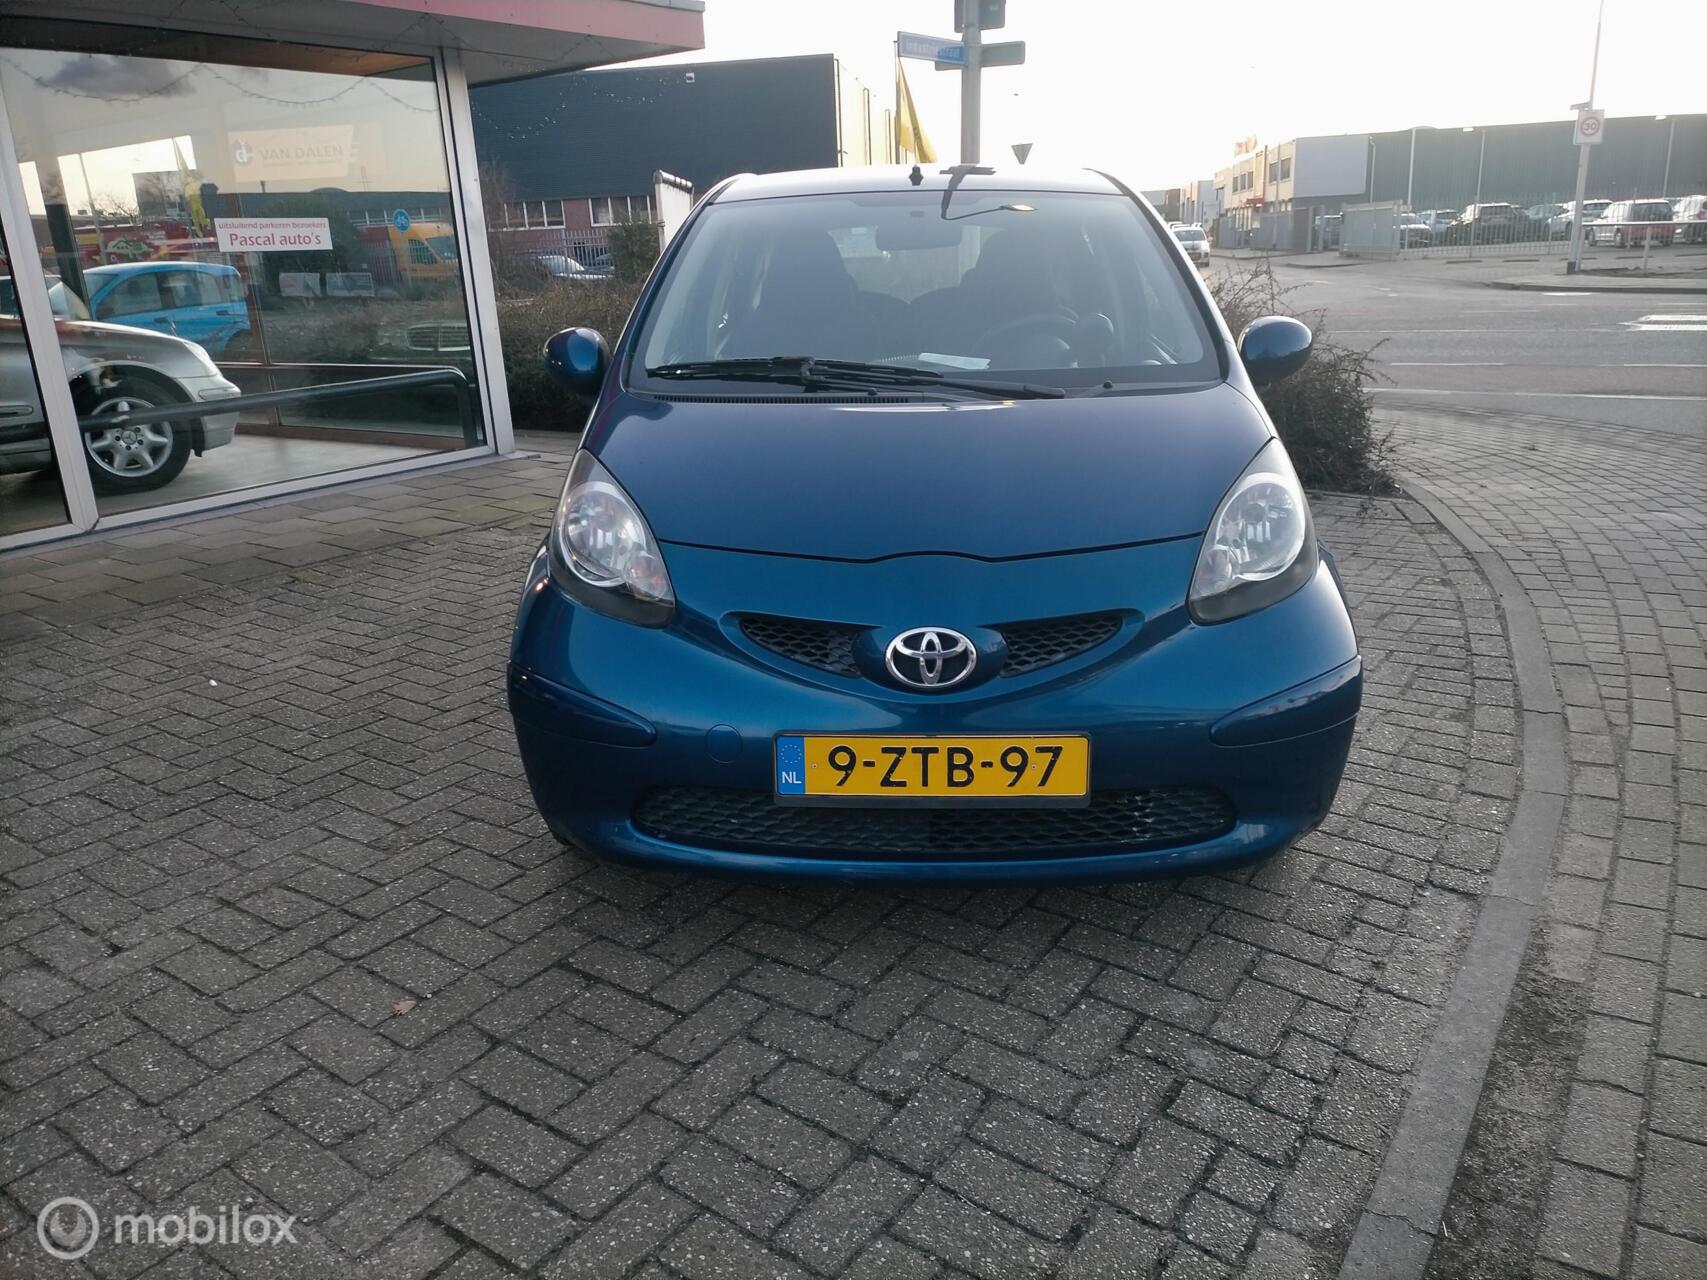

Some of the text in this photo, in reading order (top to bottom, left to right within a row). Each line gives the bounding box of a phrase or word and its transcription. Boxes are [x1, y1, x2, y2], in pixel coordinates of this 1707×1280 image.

[1583, 122, 1597, 131] 30
[229, 232, 321, 247] Pascal auto's
[827, 745, 1064, 788] 9-ZTB-97
[781, 771, 802, 785] NL
